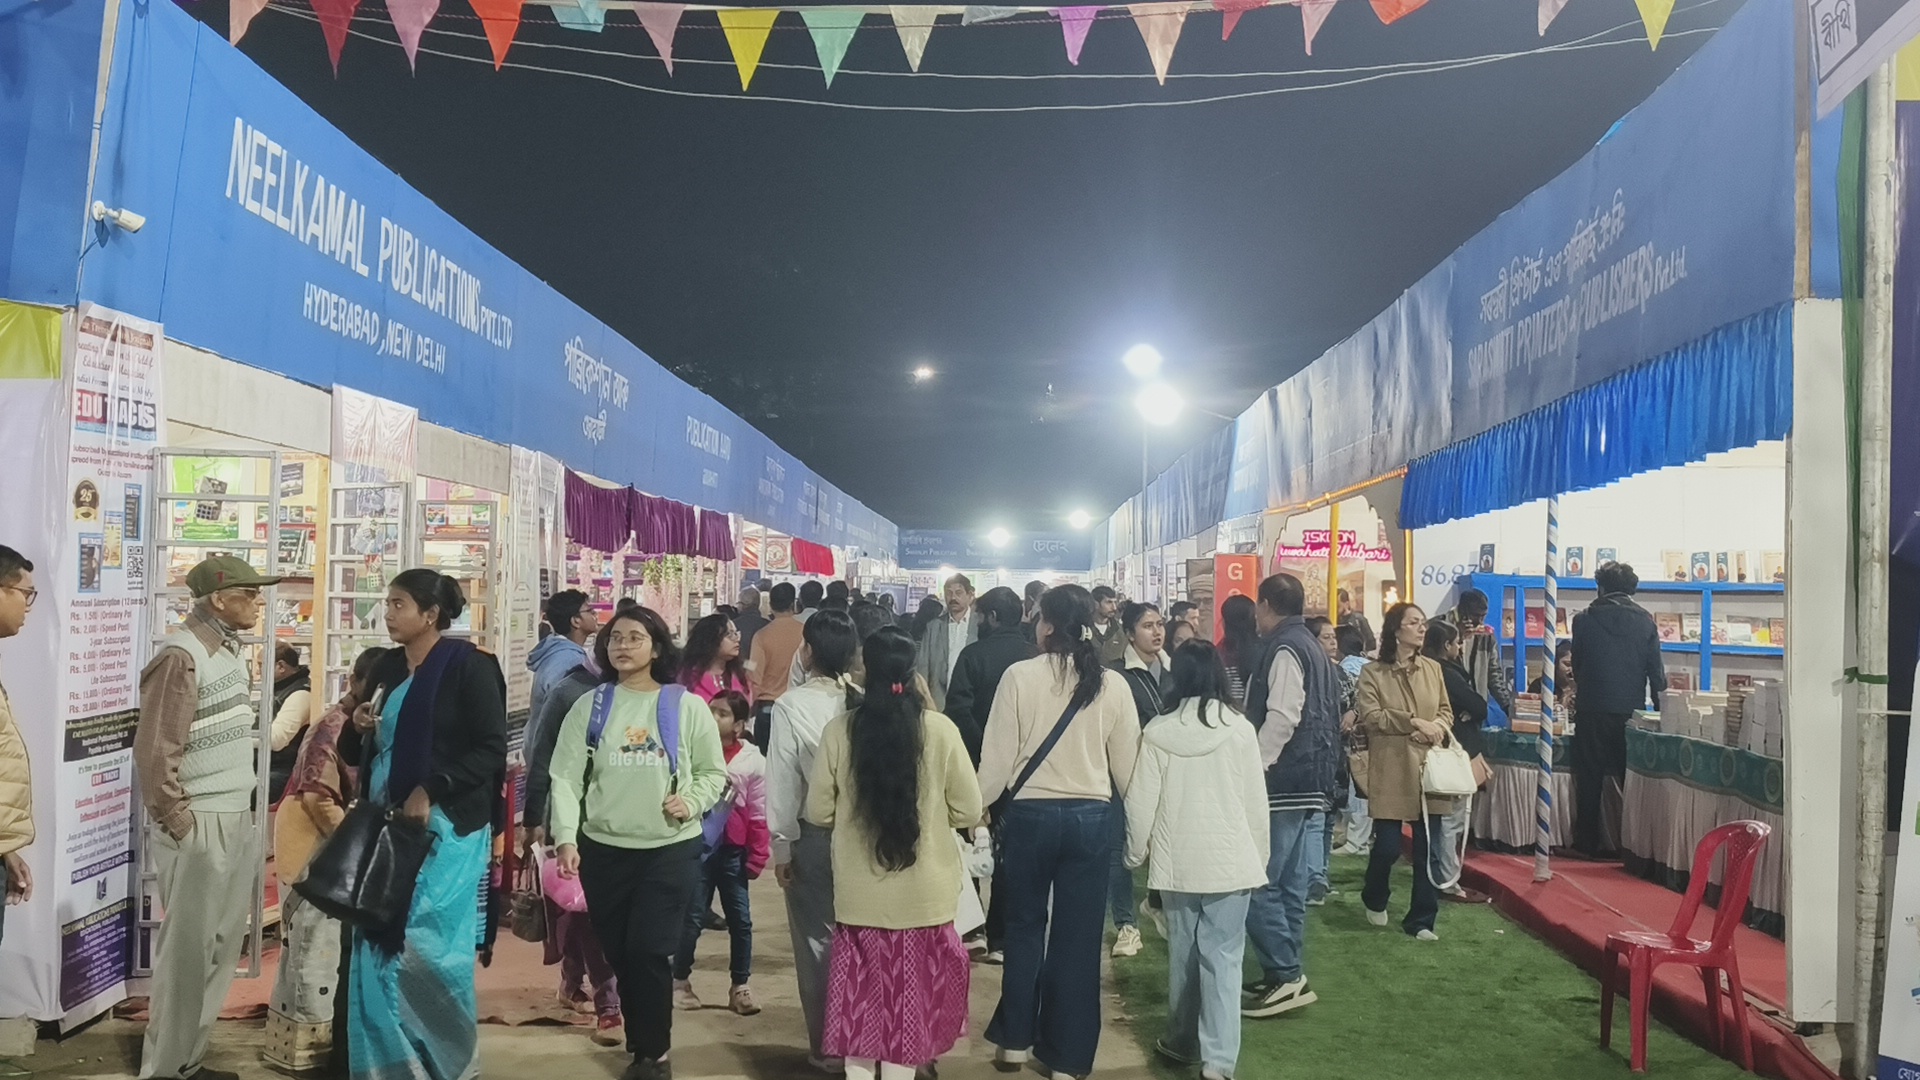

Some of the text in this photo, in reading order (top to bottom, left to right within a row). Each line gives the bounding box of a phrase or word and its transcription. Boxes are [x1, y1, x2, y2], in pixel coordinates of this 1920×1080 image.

[226, 116, 369, 278] NEELKAMAL
[377, 216, 481, 334] PUBLICATIONS
[303, 281, 379, 347] HYDERABAD
[416, 333, 446, 375] DELHI
[1517, 295, 1569, 359] PRINTERS
[1577, 241, 1654, 331] PUBLISHERS
[686, 415, 719, 457] PUBLICATION
[609, 751, 633, 766] BIG
